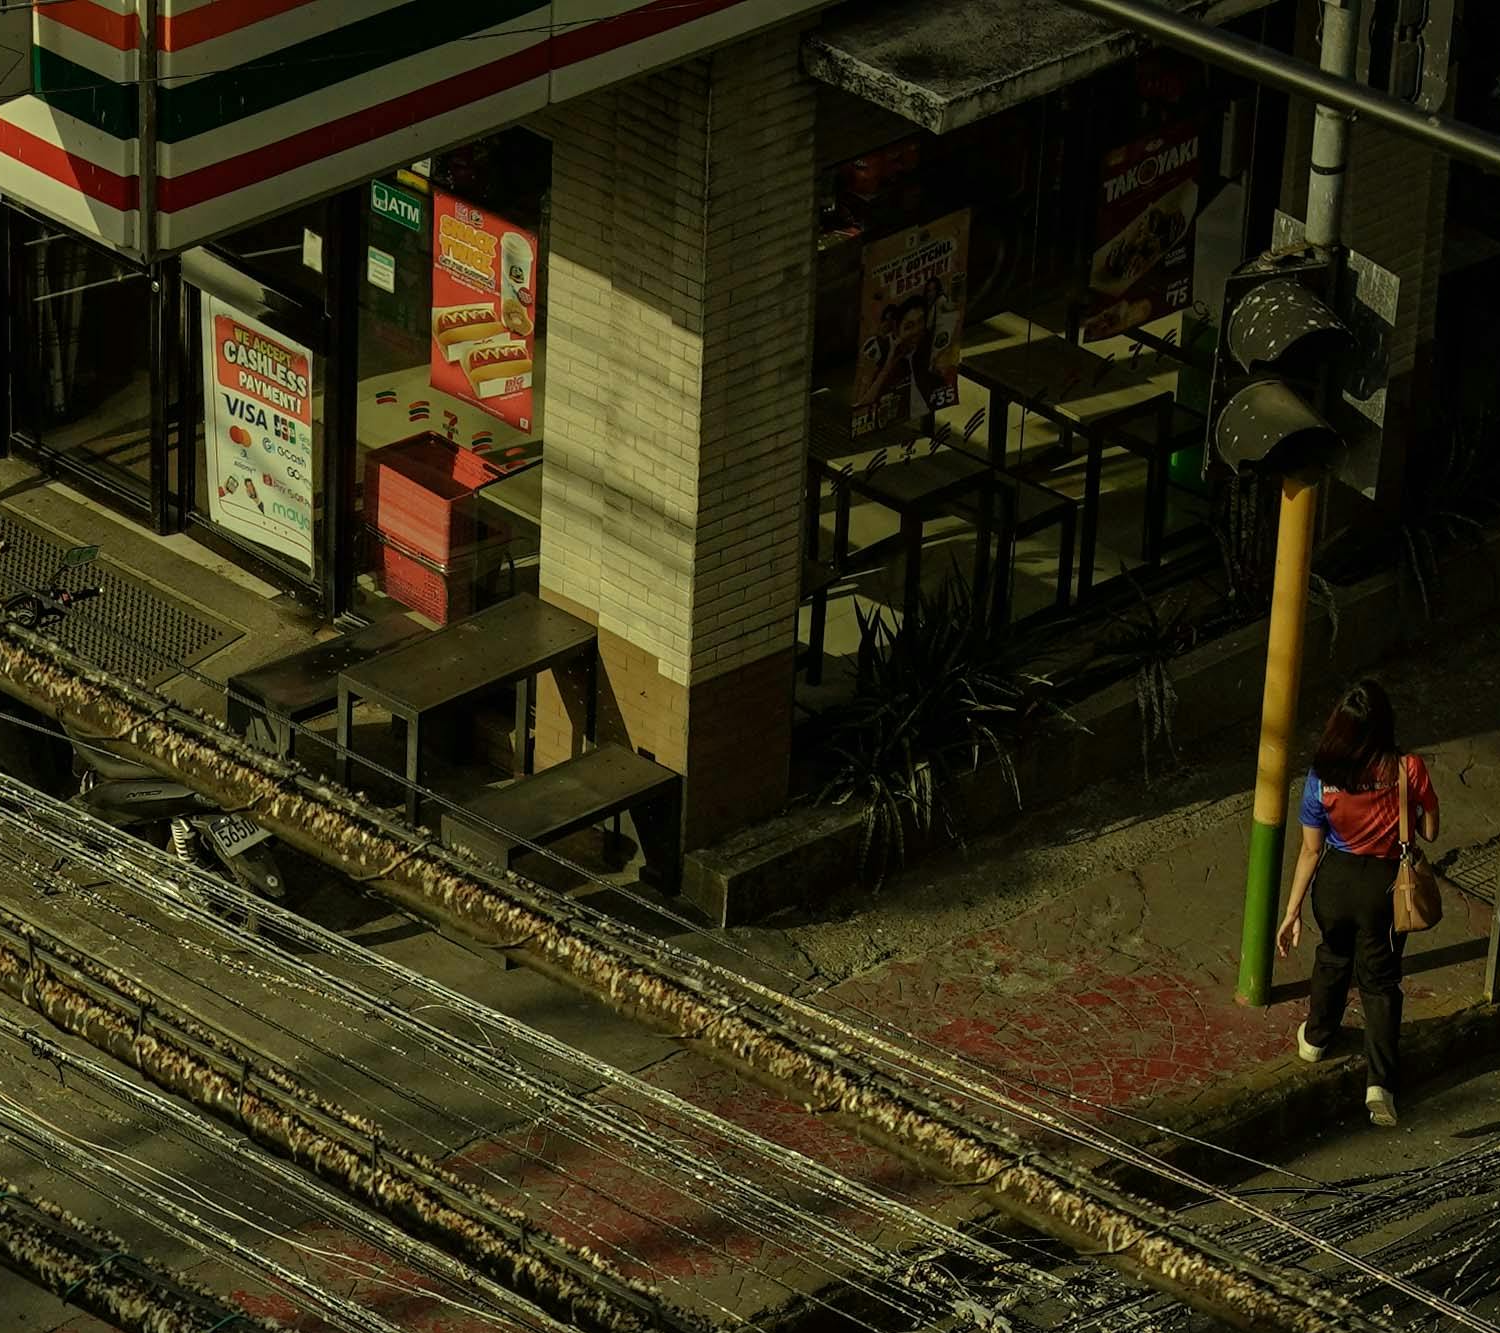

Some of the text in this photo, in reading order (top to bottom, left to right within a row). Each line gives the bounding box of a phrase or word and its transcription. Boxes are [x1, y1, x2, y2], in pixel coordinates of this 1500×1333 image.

[1104, 136, 1199, 203] TAKOYAKI
[387, 197, 420, 224] ATM
[234, 327, 292, 366] WE ACCEPT
[223, 340, 307, 398] CASHLESS
[221, 393, 267, 430] VISA
[239, 371, 302, 415] PAYMENT!
